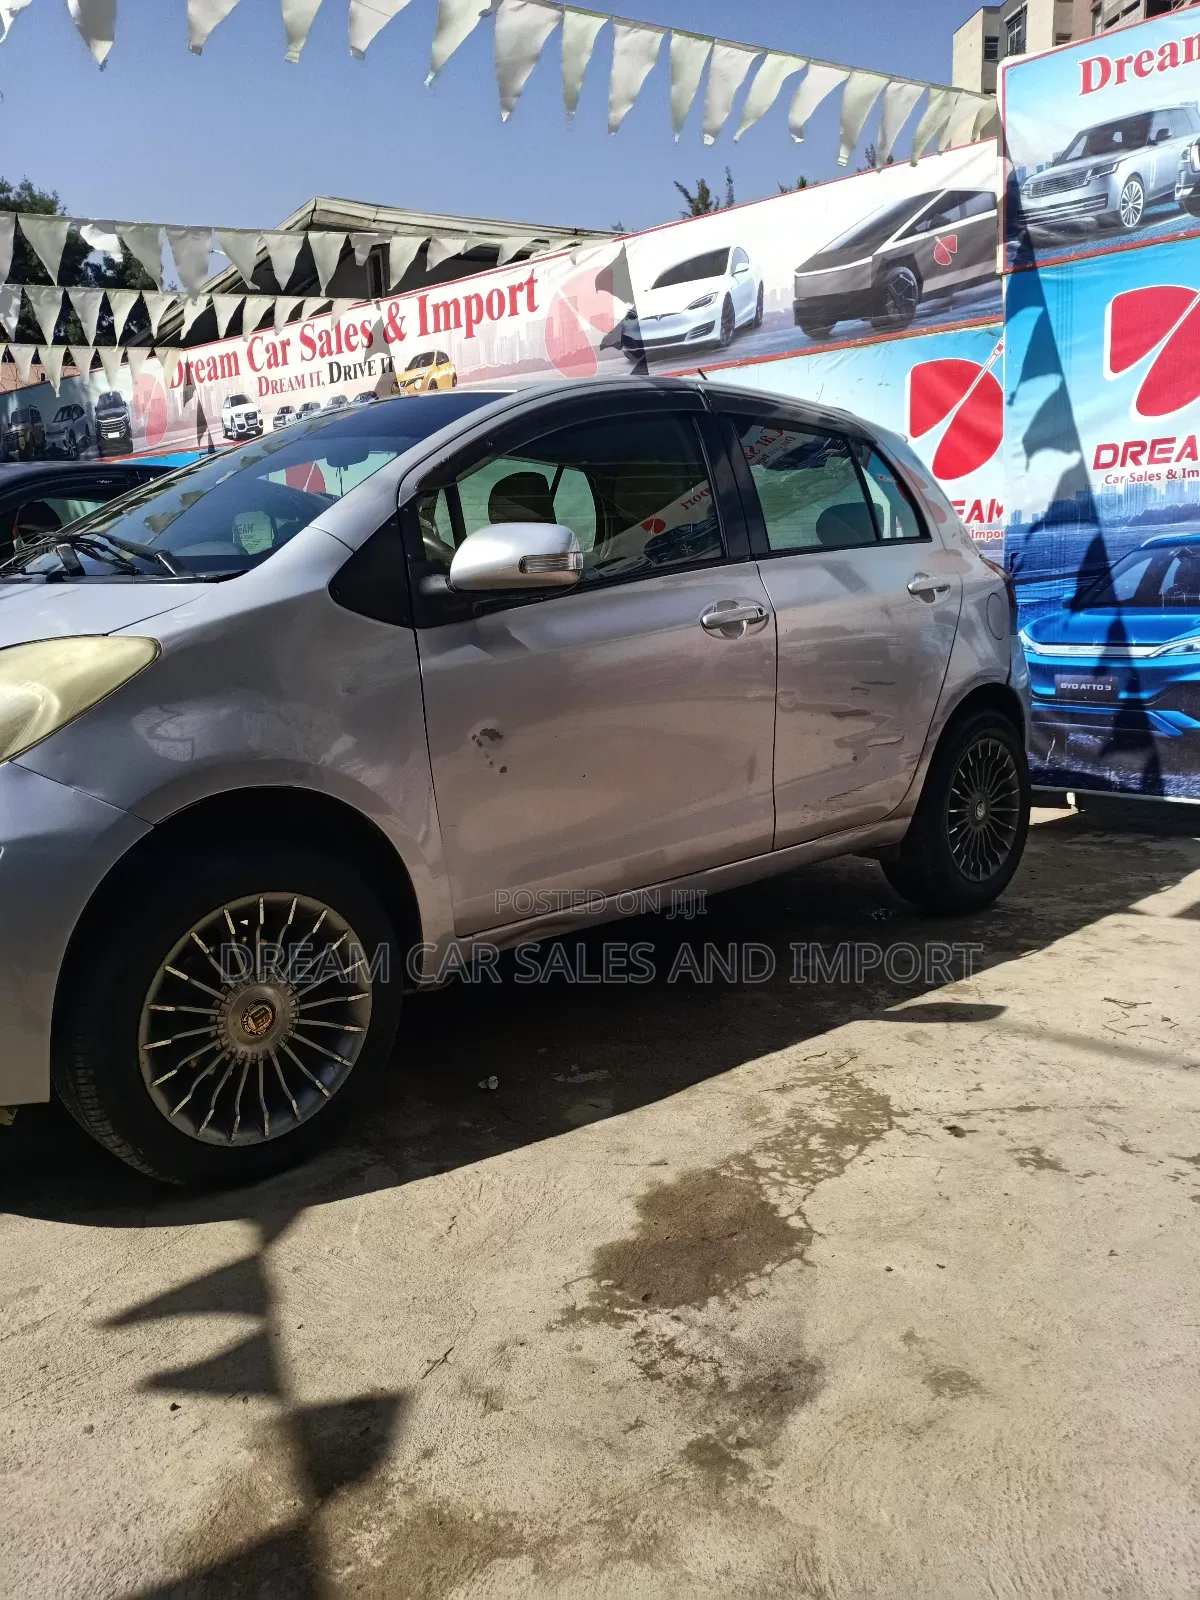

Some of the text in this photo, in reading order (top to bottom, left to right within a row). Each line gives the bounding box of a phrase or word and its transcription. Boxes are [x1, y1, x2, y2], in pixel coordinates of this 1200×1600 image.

[247, 335, 291, 372] Car
[299, 319, 373, 362] Sales
[383, 302, 407, 344] &
[417, 269, 539, 339] Import
[1104, 474, 1125, 485] Car
[1129, 471, 1162, 483] Sales
[1166, 469, 1178, 480] &
